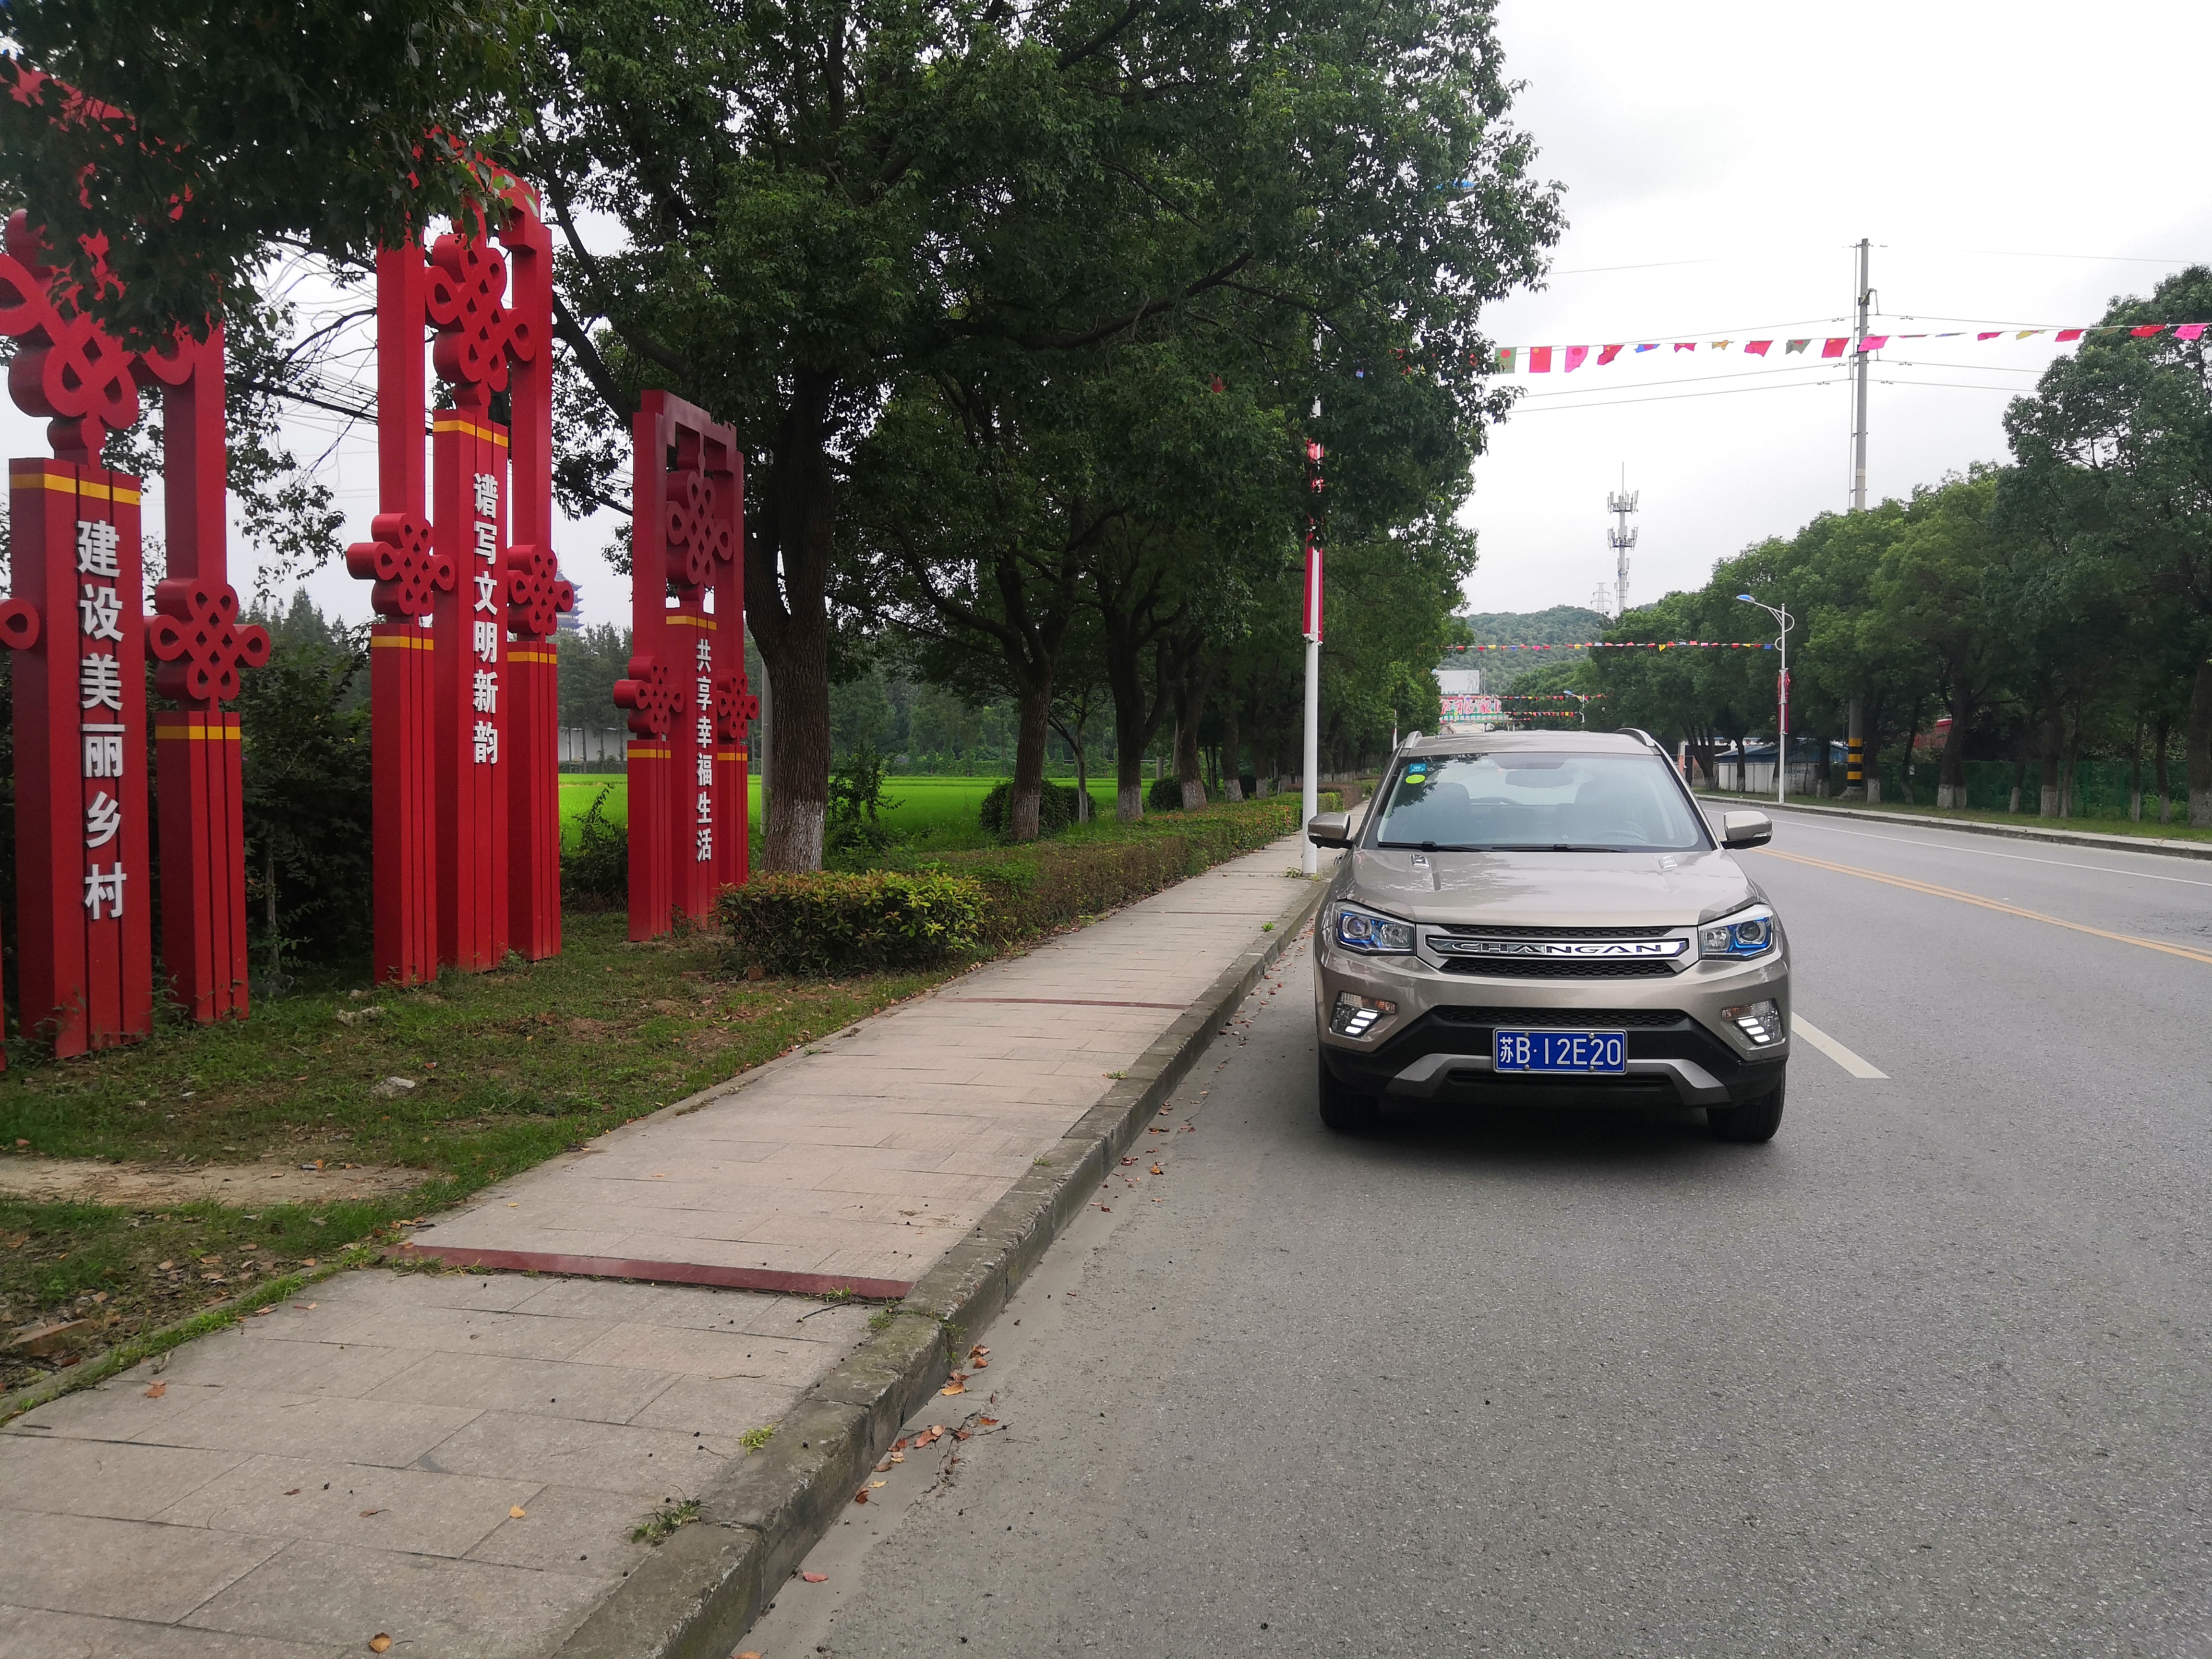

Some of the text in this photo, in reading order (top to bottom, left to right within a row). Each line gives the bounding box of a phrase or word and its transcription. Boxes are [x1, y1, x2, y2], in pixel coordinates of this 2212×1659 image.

[77, 519, 127, 920] 建设美丽乡村
[472, 472, 499, 765] 谱写文明新韵
[696, 638, 713, 863] 共享幸福生活
[1451, 942, 1662, 954] CHANGAN
